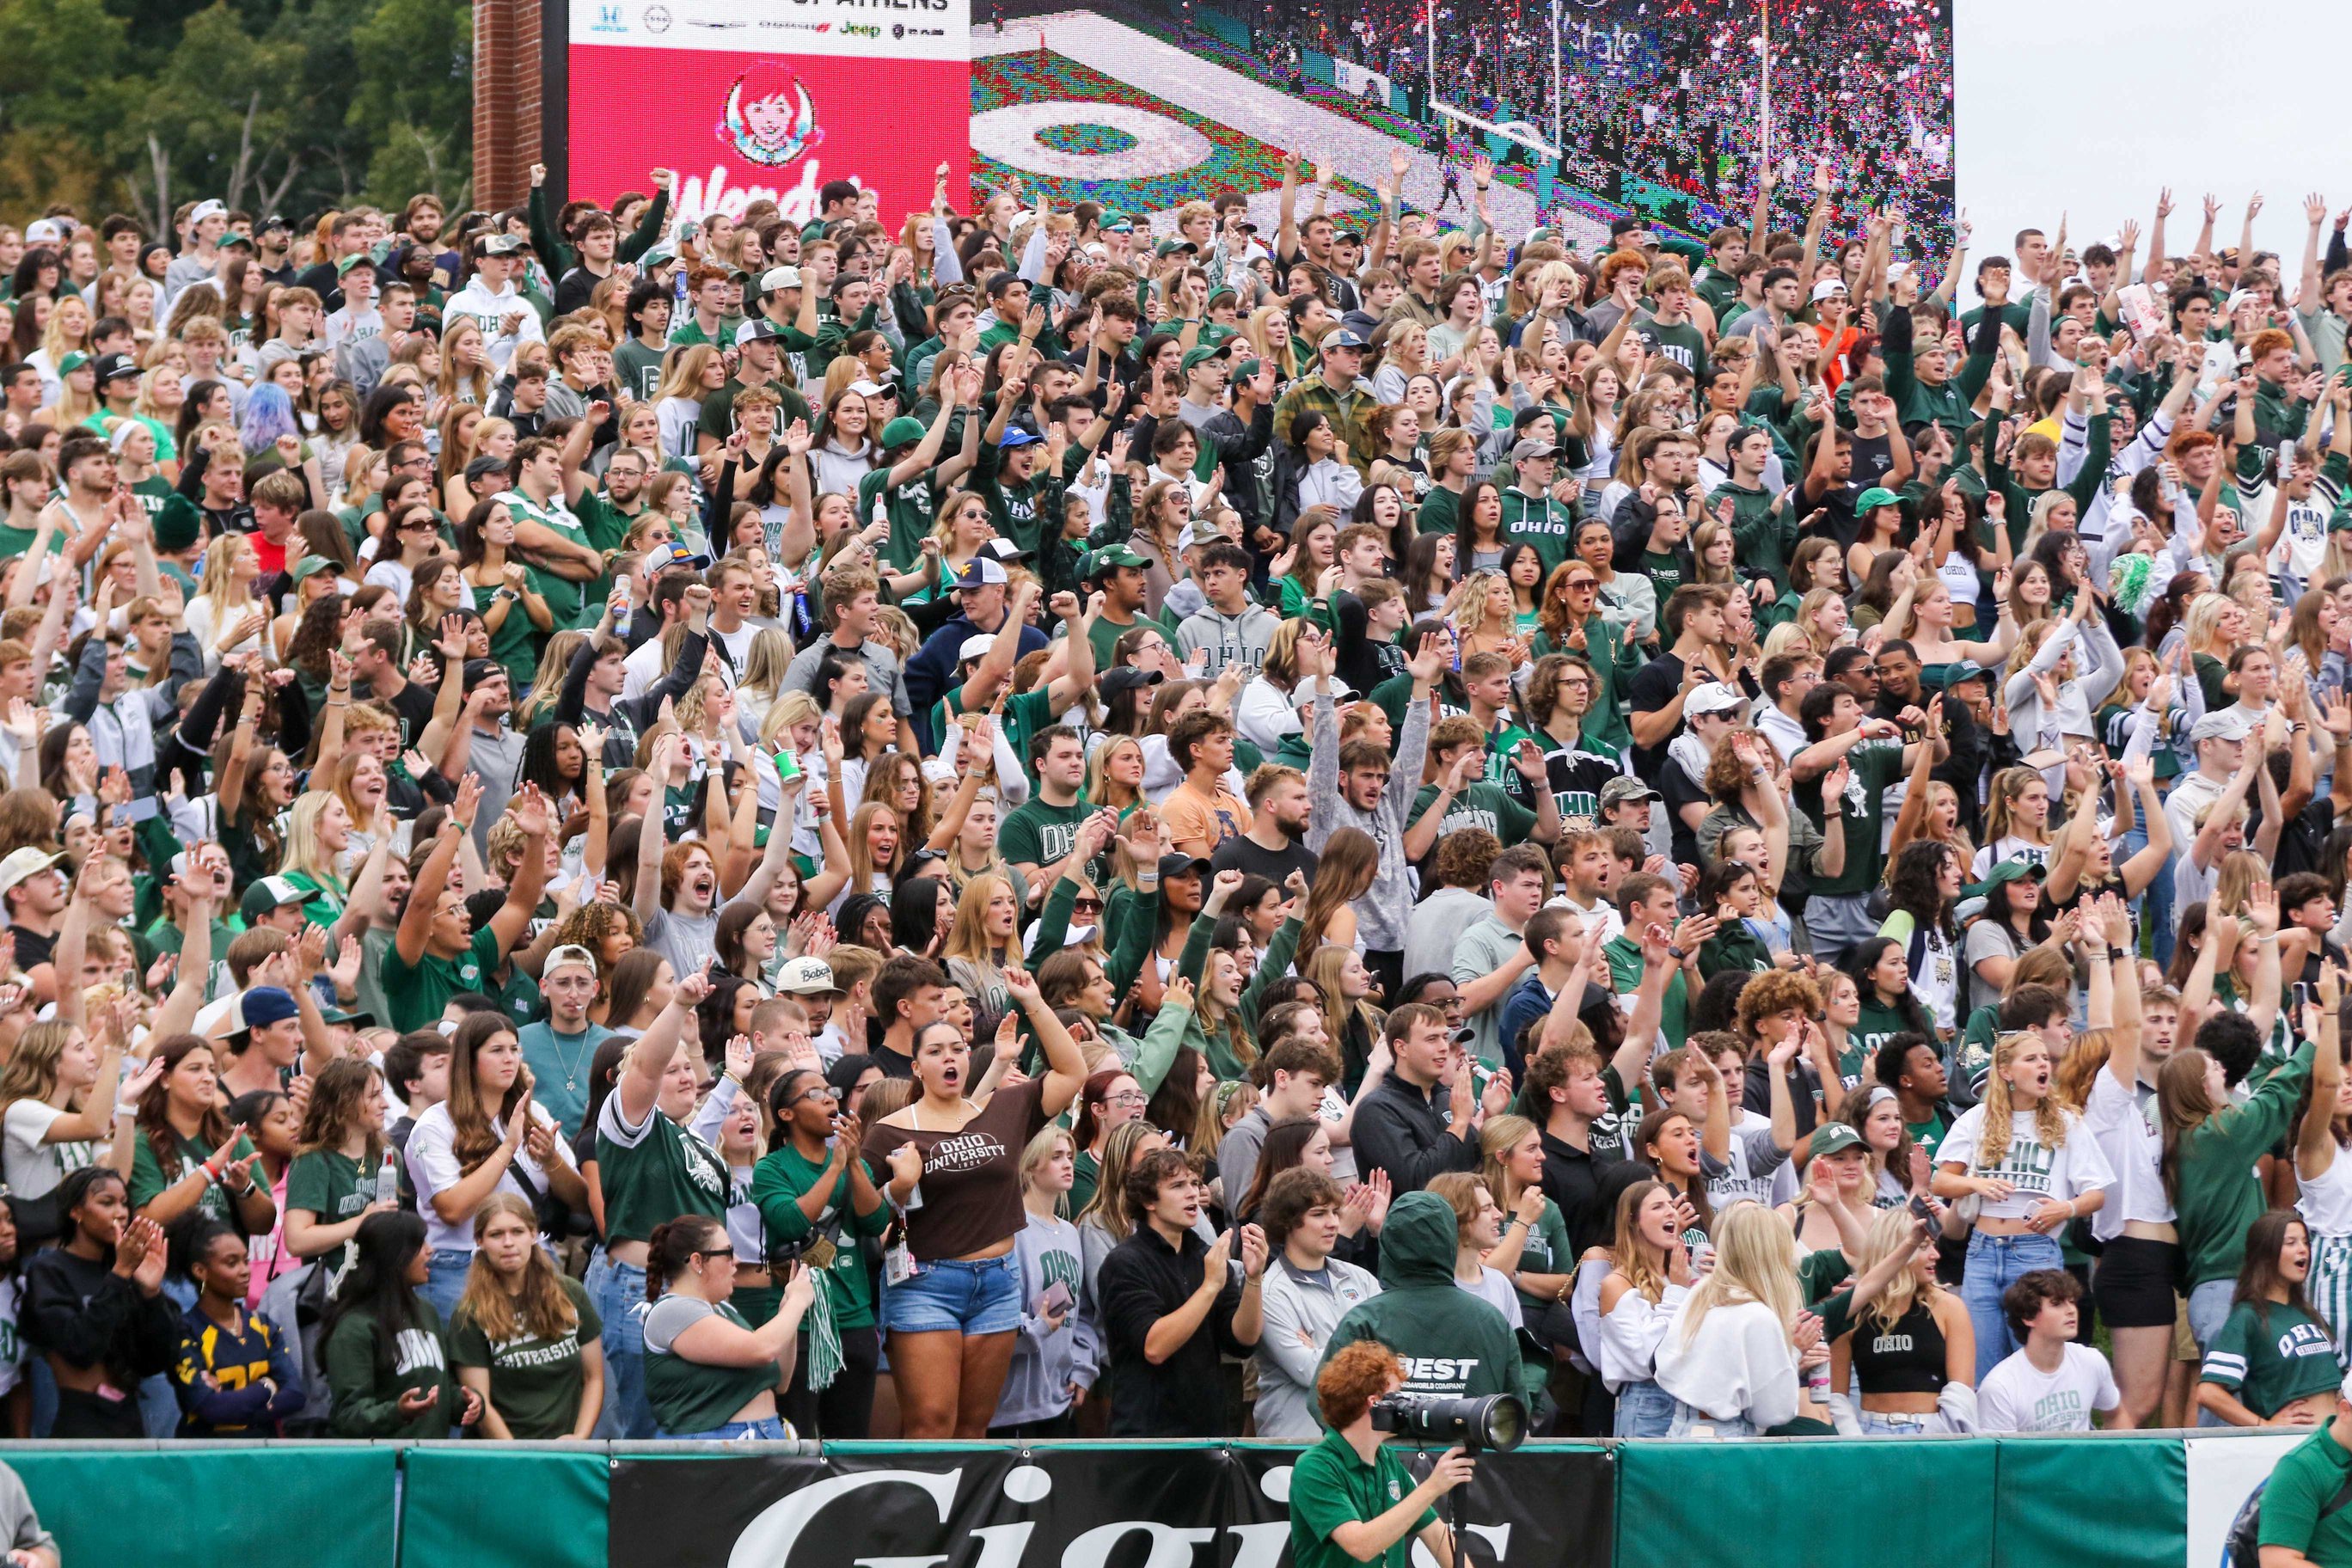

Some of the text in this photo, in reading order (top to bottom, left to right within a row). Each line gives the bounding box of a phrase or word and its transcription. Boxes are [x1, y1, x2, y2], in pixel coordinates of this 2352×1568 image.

[1510, 521, 1565, 535] OHIO
[1945, 565, 1967, 576] OHIO
[1038, 823, 1081, 864] OH
[940, 1136, 986, 1155] OHIO
[924, 1144, 1005, 1173] UNIVERSITY
[958, 1158, 981, 1169] 1804
[1978, 1139, 2055, 1174] HIO
[1679, 1228, 1710, 1246] HIO
[1039, 1249, 1081, 1293] OHIO
[1872, 1334, 1913, 1353] OHIO
[2278, 1323, 2331, 1359] OHI
[1399, 1357, 1479, 1380] BEST
[1435, 1381, 1467, 1390] COMPANY
[2034, 1389, 2082, 1421] OHIO
